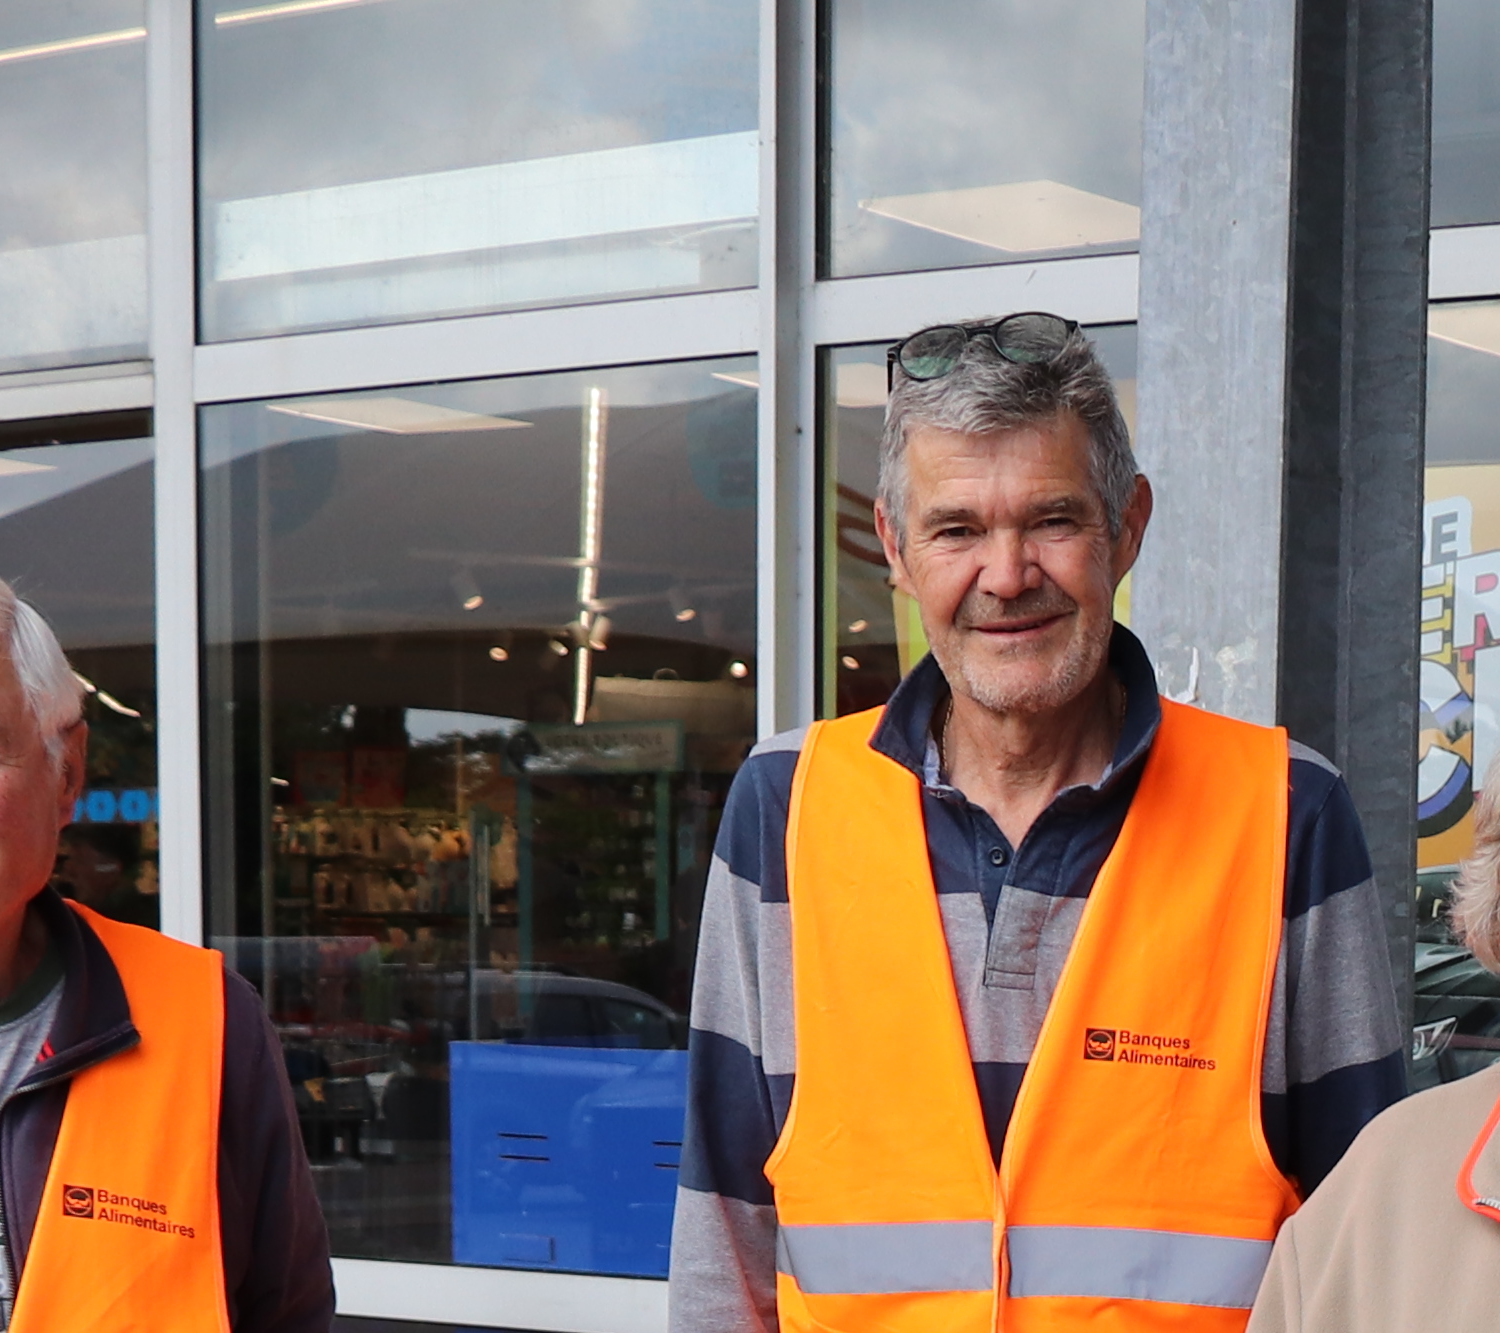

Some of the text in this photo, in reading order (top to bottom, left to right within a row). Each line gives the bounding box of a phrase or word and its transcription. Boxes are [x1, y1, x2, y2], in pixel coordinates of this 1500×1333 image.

[1119, 1030, 1190, 1050] Banques
[1118, 1049, 1216, 1070] Alimentaires
[97, 1189, 168, 1215] Banques
[97, 1207, 196, 1239] Alimentaires
